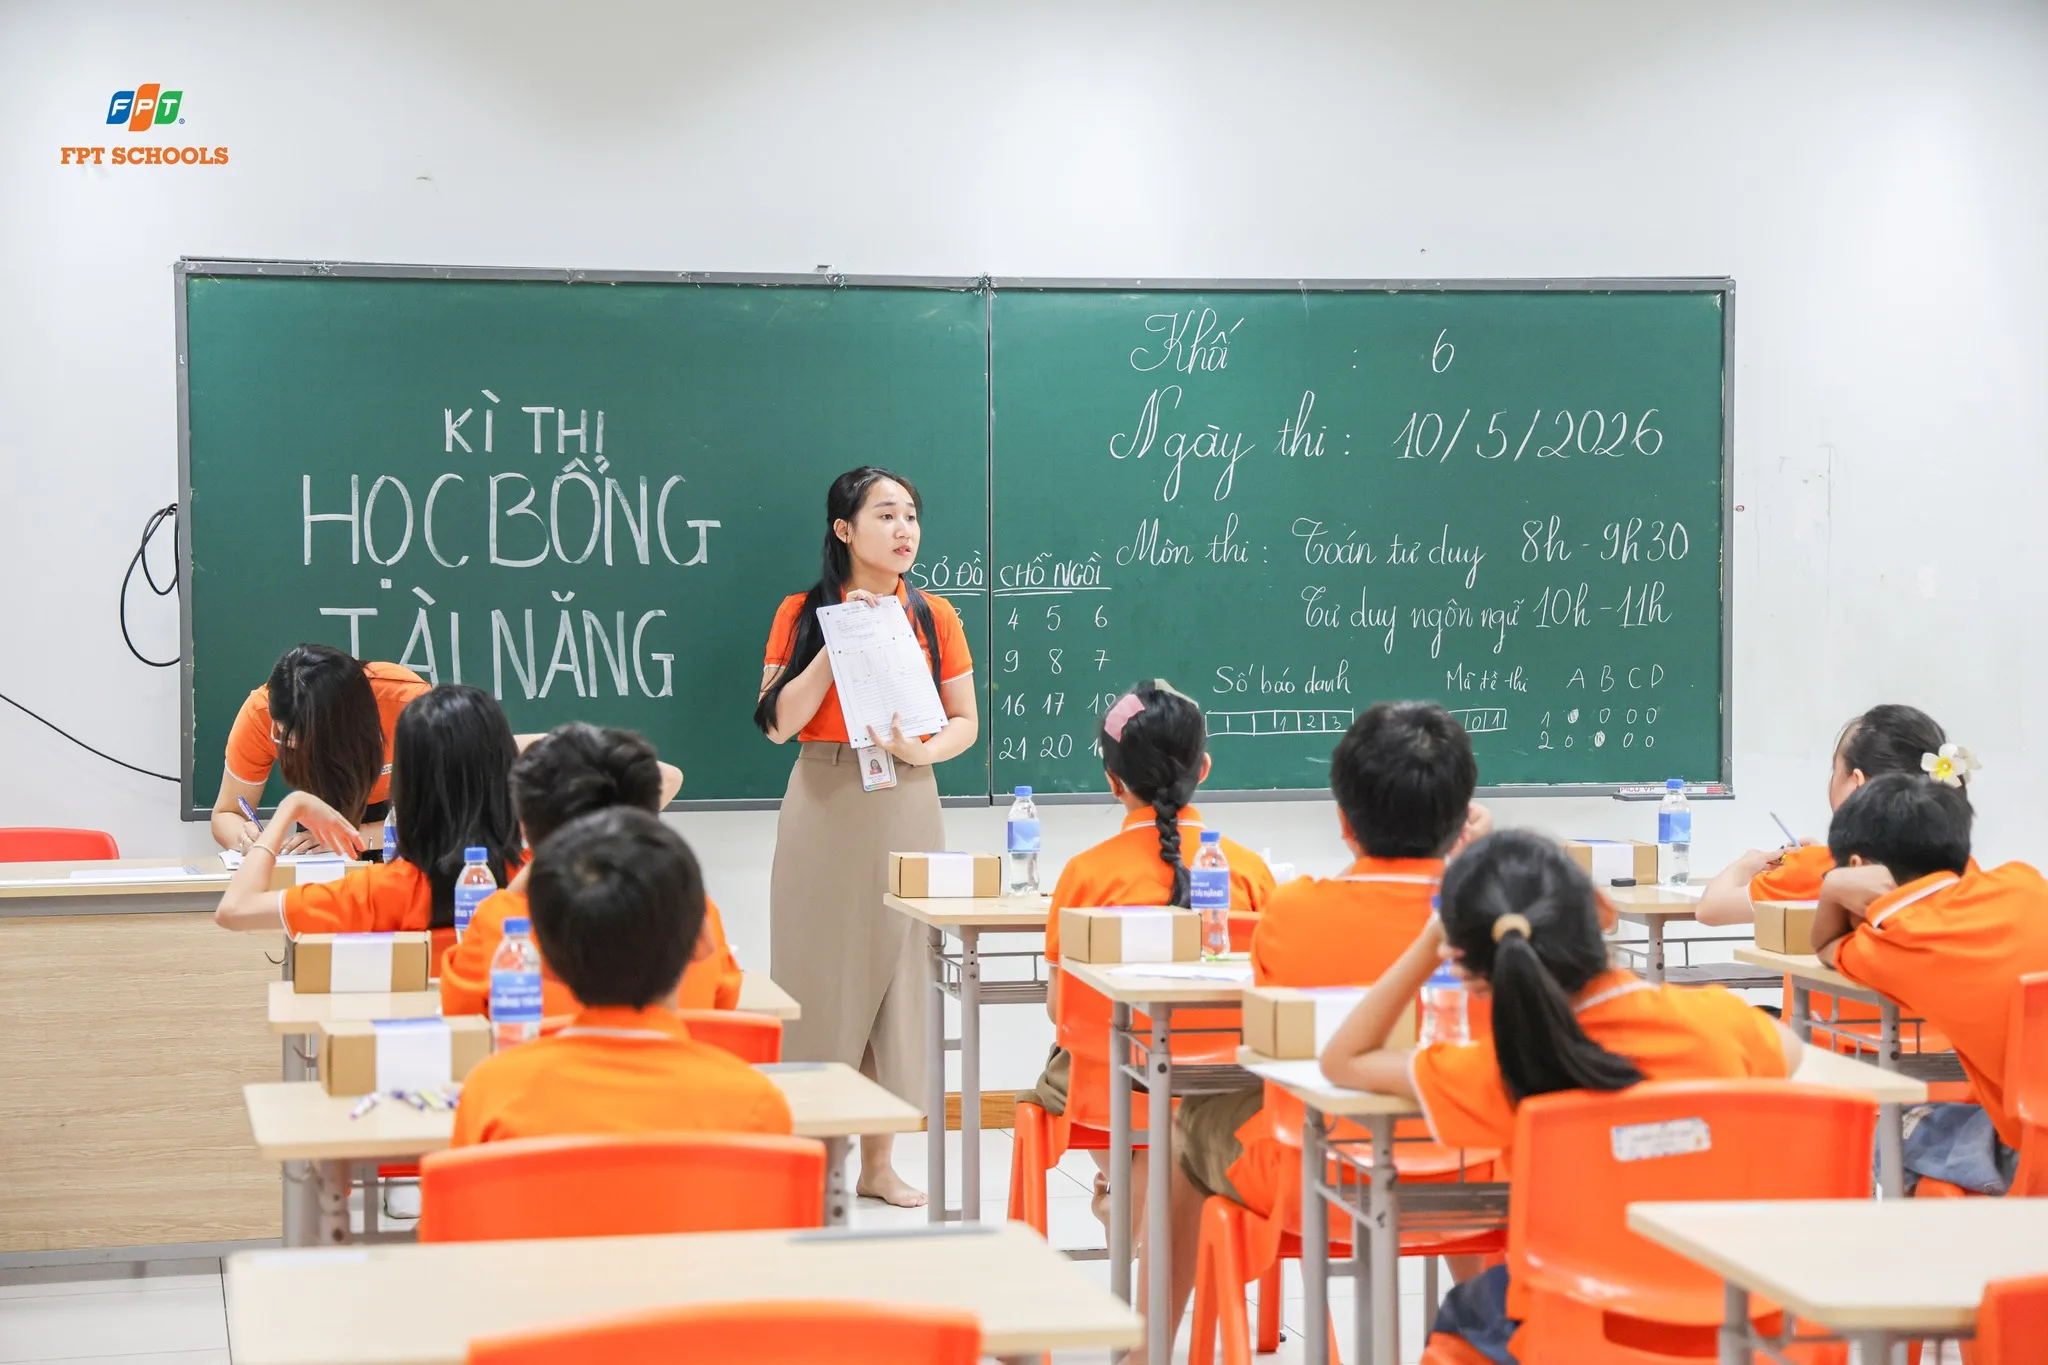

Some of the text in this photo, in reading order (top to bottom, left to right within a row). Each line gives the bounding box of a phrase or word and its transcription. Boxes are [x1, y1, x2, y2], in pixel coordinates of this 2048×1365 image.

[1130, 307, 1245, 375] Khối
[1431, 328, 1456, 374] 6
[444, 389, 605, 454] KÌ THI
[1109, 385, 1256, 503] Ngày
[303, 455, 722, 588] HỌC BỔNG
[955, 550, 983, 587] ĐỒ
[1000, 552, 1052, 588] CHỖ
[1053, 551, 1102, 587] NGỒI
[1116, 517, 1194, 566] Môn
[1291, 517, 1377, 565] Toán
[1386, 533, 1421, 565] tư
[1428, 523, 1488, 590] duy
[1521, 515, 1572, 565] 8h
[1007, 606, 1019, 631] 4
[1046, 605, 1061, 631] 5
[1094, 604, 1108, 628] 6
[1301, 585, 1340, 629] Tư
[1350, 586, 1397, 655] duy
[1410, 598, 1474, 660] ngôn
[1481, 598, 1525, 655] ngữ
[319, 586, 675, 701] TÀI NĂNG
[1003, 648, 1111, 675] 9 8 7
[1213, 659, 1352, 694] Số báo danh
[1447, 662, 1476, 691] Mã
[1505, 665, 1529, 692] thi
[1566, 663, 1664, 693] A B C D
[1001, 692, 1025, 716] 16
[1042, 692, 1065, 716] 17
[999, 735, 1027, 760] 21
[1040, 733, 1073, 760] 20
[1538, 730, 1554, 749] 2
